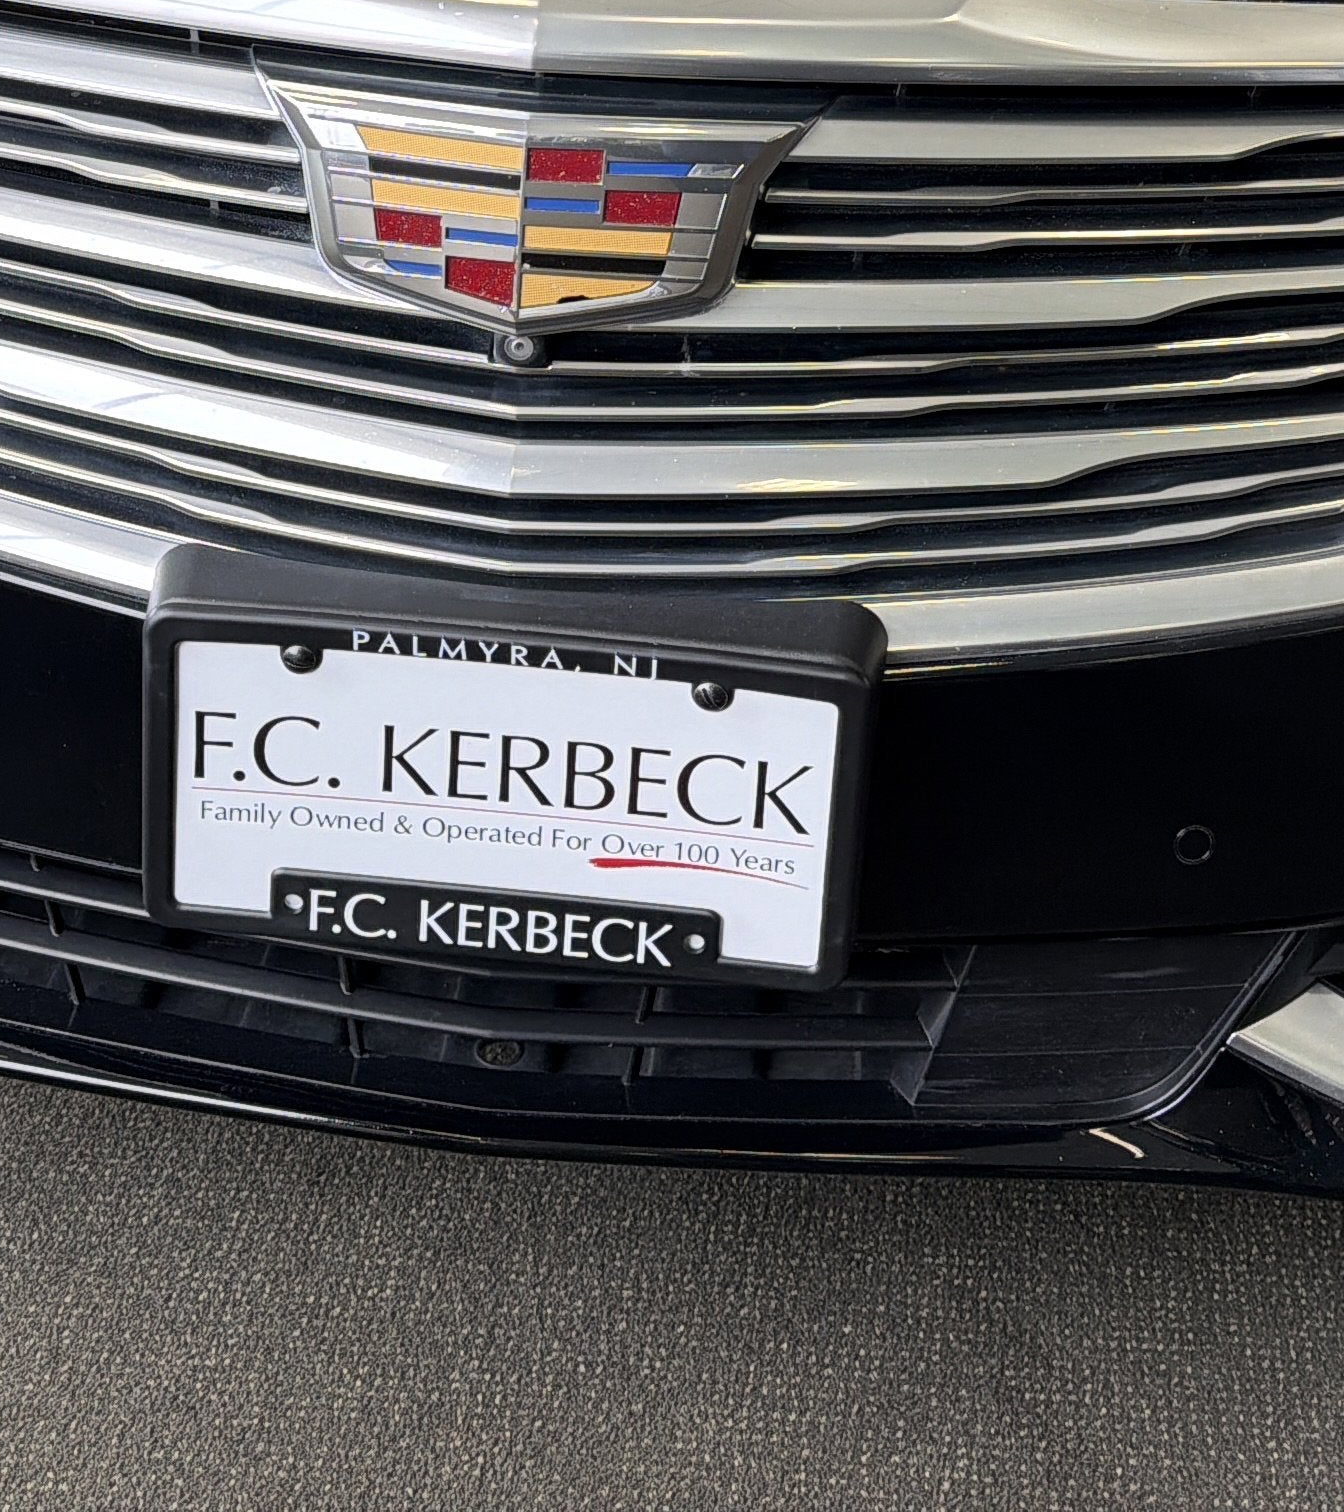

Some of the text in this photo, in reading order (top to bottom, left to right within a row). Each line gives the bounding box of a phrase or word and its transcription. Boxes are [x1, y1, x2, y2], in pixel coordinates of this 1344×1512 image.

[352, 628, 658, 681] PALMYRA, NJ
[193, 710, 814, 836] F.C. KERBECK
[201, 800, 795, 875] Family Owned & Operated For Over 100 Years
[309, 888, 674, 968] F.C. KERBECK
